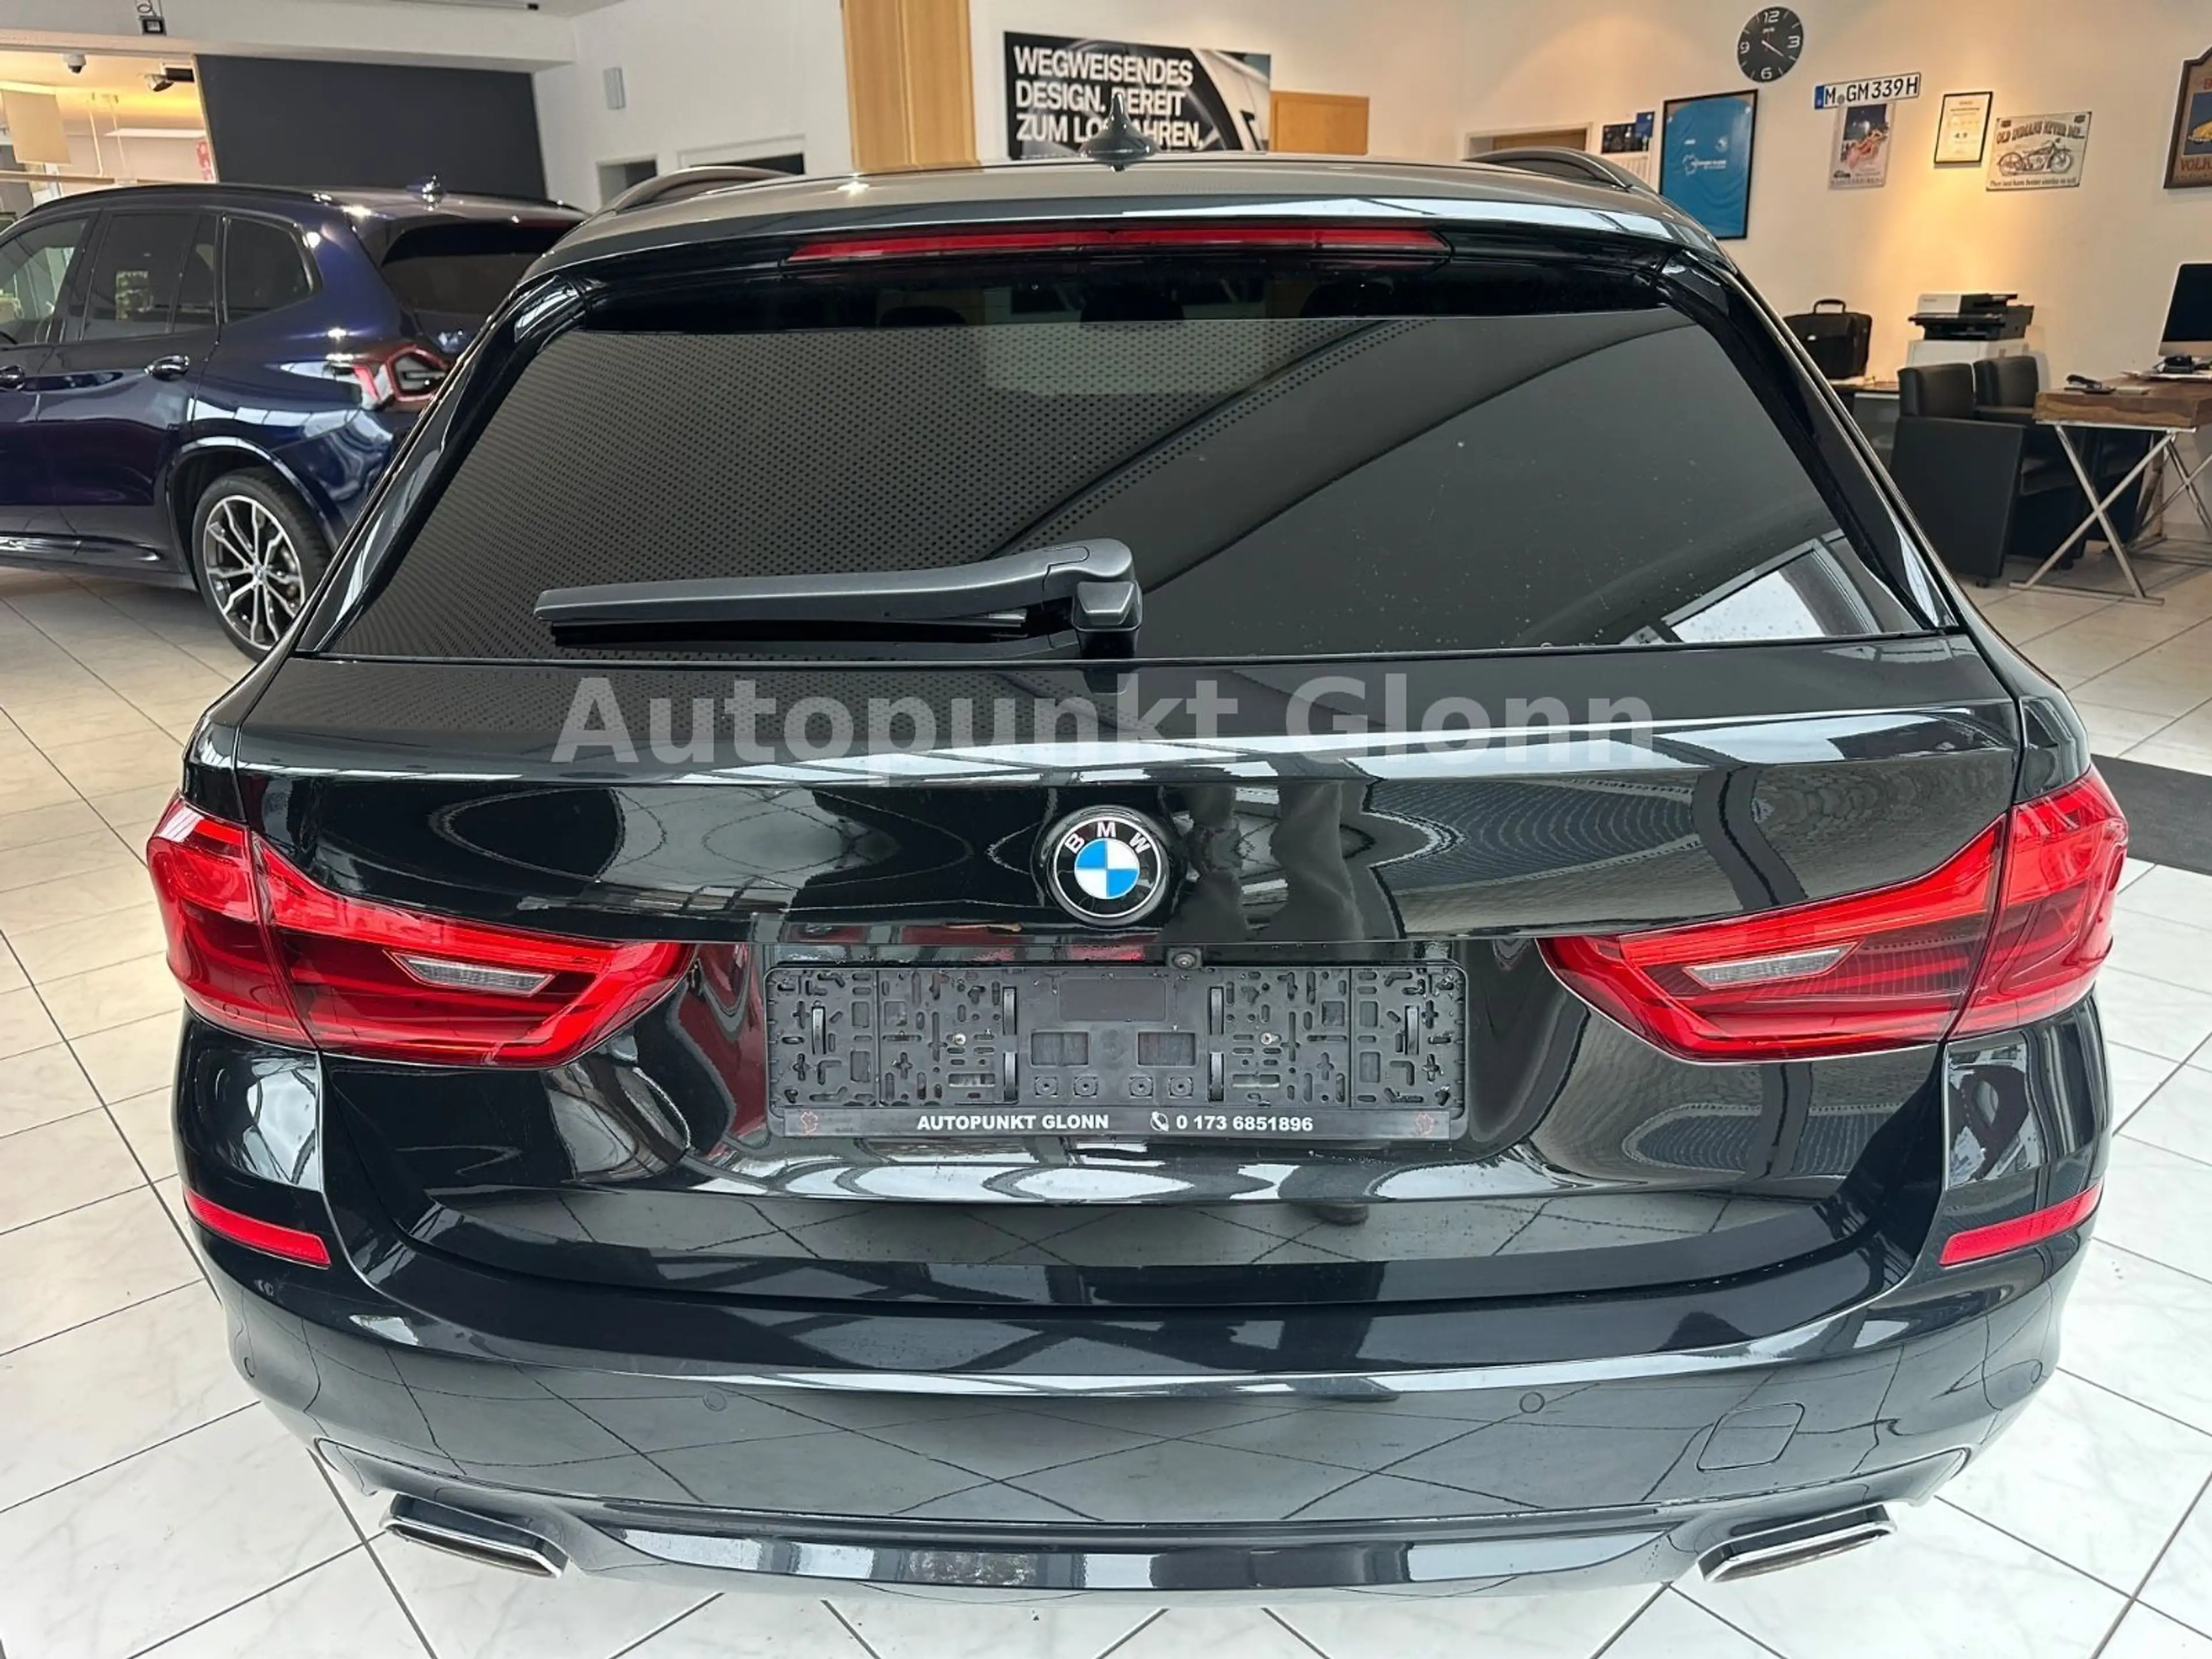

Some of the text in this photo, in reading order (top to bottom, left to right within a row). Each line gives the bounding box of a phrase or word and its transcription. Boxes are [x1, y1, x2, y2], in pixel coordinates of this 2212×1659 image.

[1764, 10, 1780, 24] 12
[1740, 41, 1750, 54] 9
[1786, 35, 1800, 49] 3
[1013, 46, 1194, 87] WEGWEISENDES
[1760, 66, 1772, 79] 6
[1015, 79, 1107, 113] DESIGN.
[1016, 113, 1068, 142] ZUM
[1065, 821, 1151, 854] BMW
[917, 1115, 1313, 1131] AUTOPUNKT GLONN 0 173 6851896
